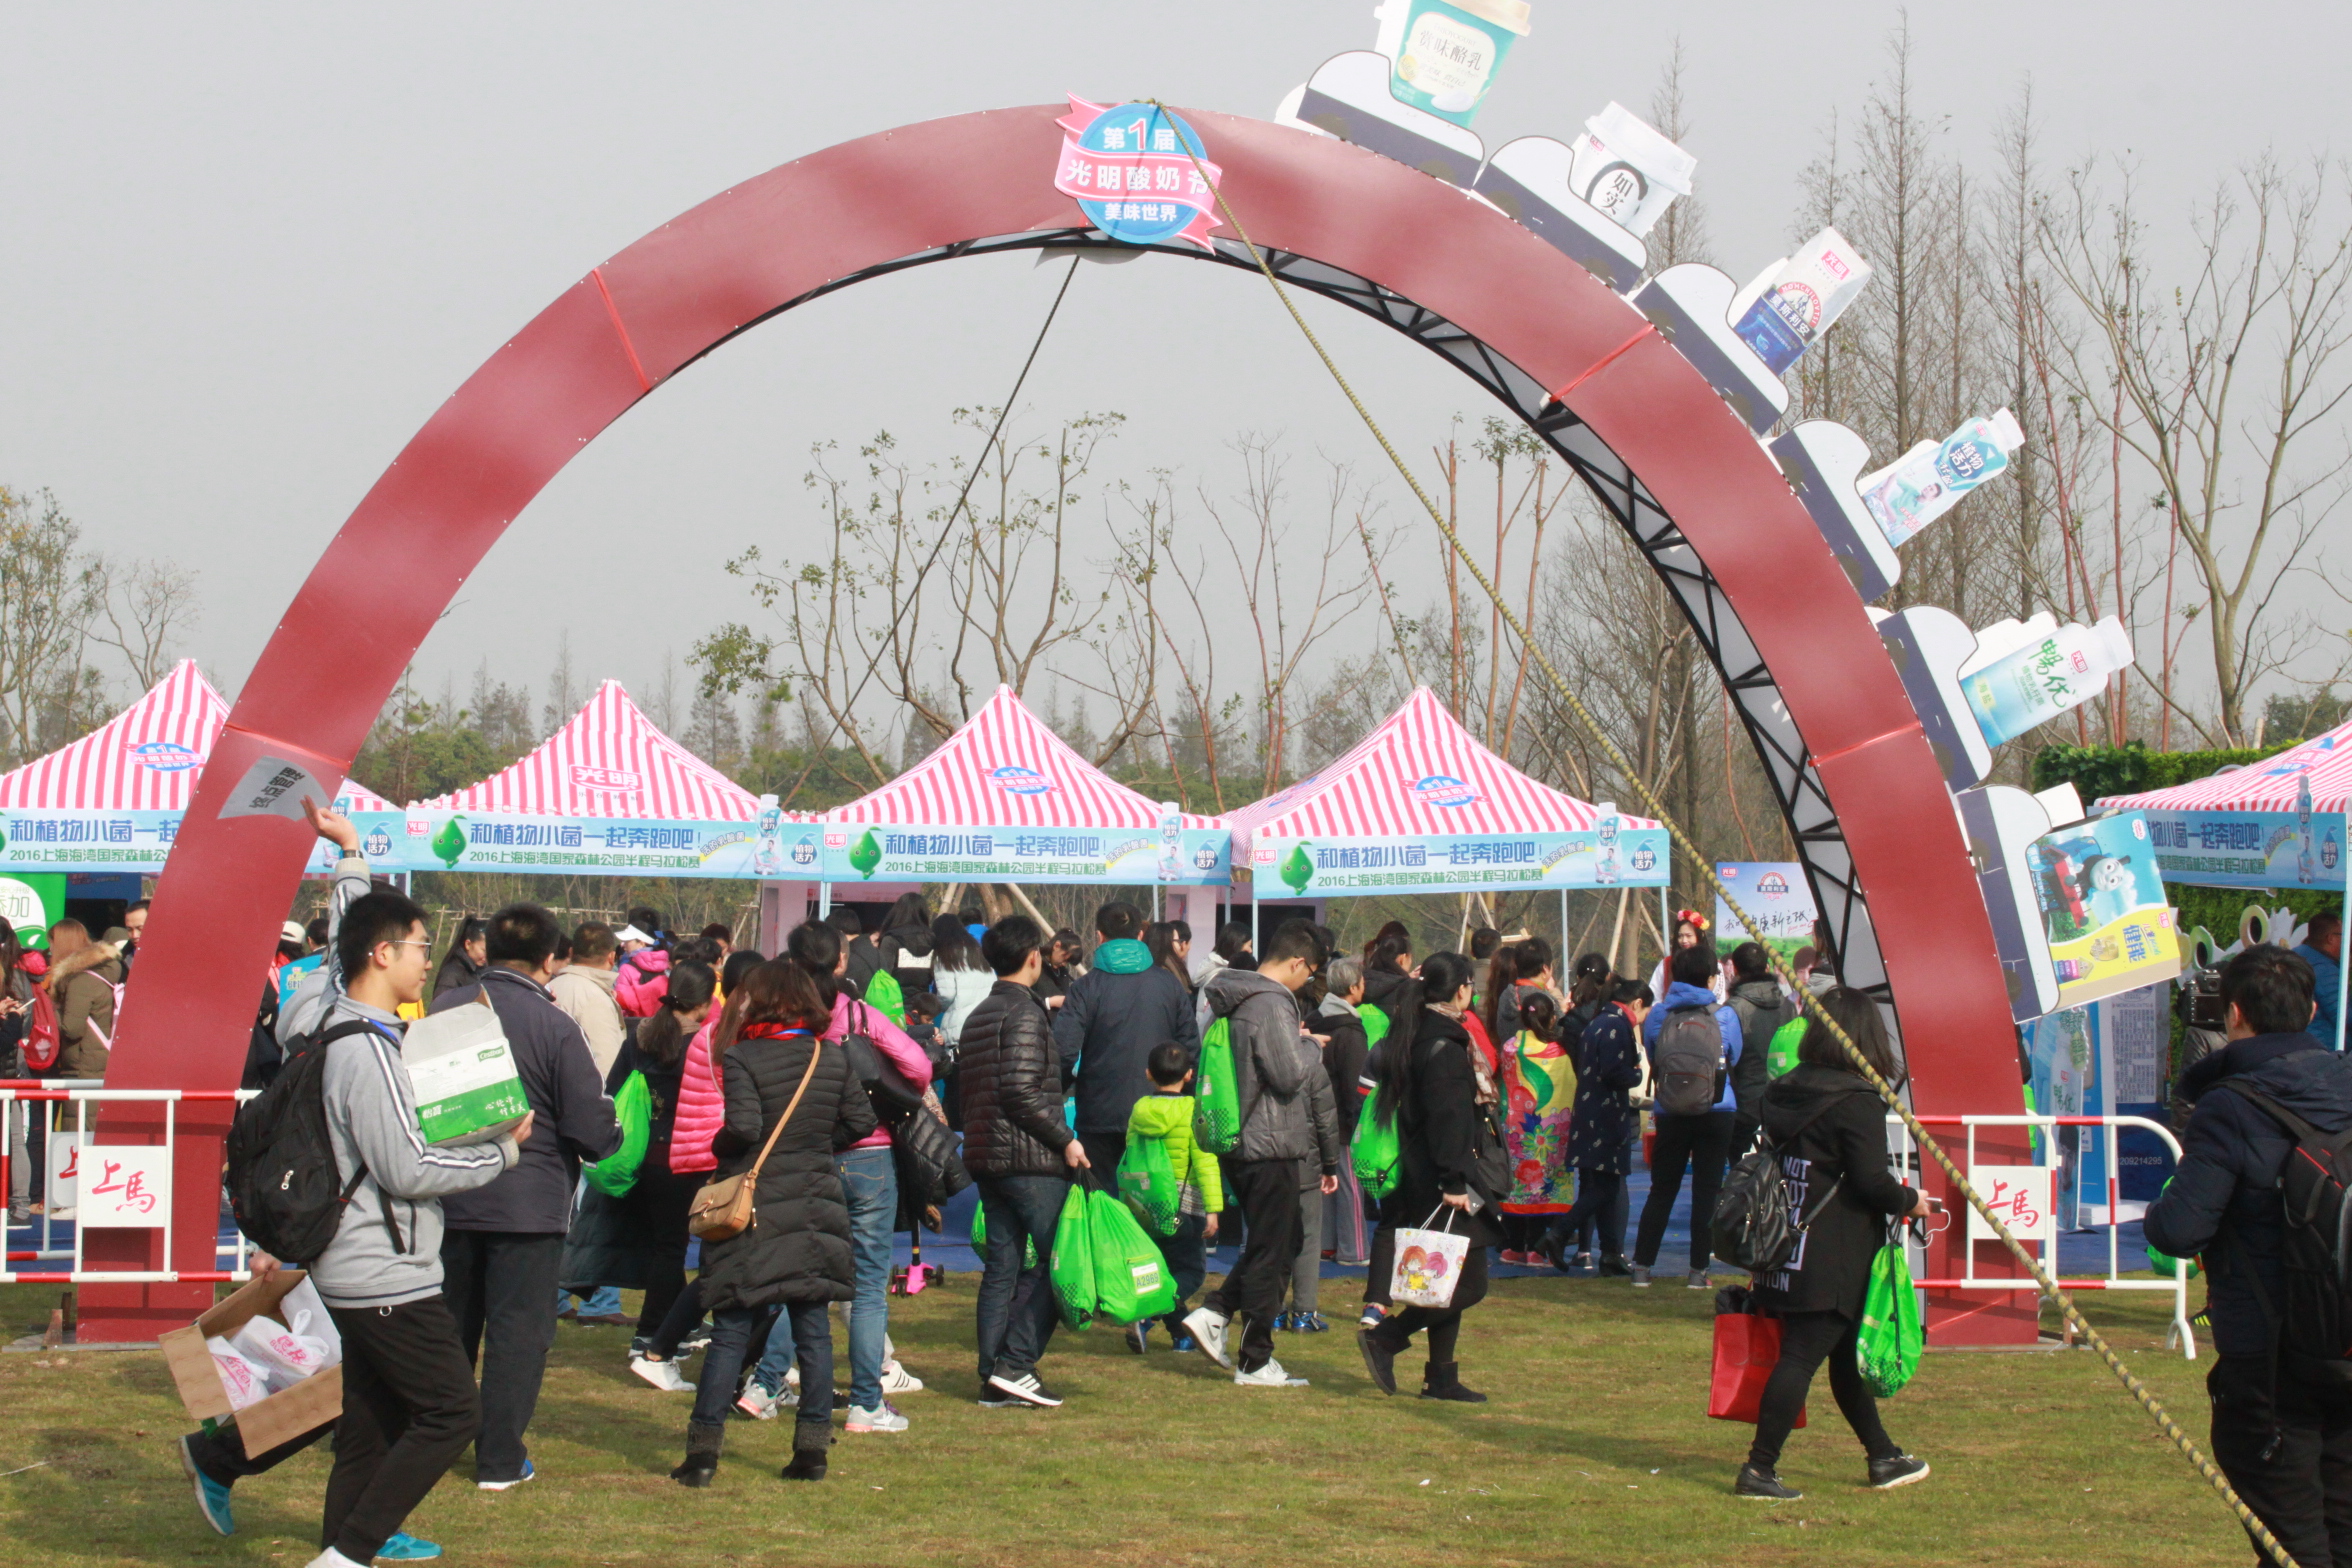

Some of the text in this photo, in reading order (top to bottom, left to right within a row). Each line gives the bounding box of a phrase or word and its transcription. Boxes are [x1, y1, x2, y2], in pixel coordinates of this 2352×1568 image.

[1419, 30, 1482, 71] 赏味酪乳
[1103, 118, 1175, 151] 第1届
[1065, 159, 1213, 195] 光明酸奶节
[1600, 172, 1634, 216] 如实
[1105, 202, 1177, 222] 美味世界
[1825, 251, 1848, 278] 光明
[1781, 282, 1820, 325] MOMCHILOVTSI
[1769, 293, 1810, 337] 莫斯利安
[1950, 448, 1975, 478] 活力
[1961, 440, 1984, 470] 植物
[2071, 650, 2087, 672] 光明
[248, 766, 305, 809] 终点管理
[576, 768, 639, 787] 光明
[408, 822, 428, 831] 光明
[470, 823, 701, 850] 和植物小菌一起奔跑吧！
[2147, 820, 2265, 851] 物小菌一起奔跑吧！
[368, 834, 388, 844] 植物
[368, 844, 388, 854] 活力
[700, 831, 746, 857] 活的乳酸菌
[794, 843, 814, 854] 植物
[826, 835, 846, 845] 光明
[885, 834, 1106, 858] 和植物小菌一起奔跑吧！
[10, 848, 171, 863] 2016上海海湾国家森林公
[470, 851, 700, 869] 2016上海海湾国家森林公园半程马拉松赛
[794, 853, 814, 863] 活力
[1196, 850, 1215, 859] 植物
[1196, 859, 1215, 868] 活力
[1255, 850, 1275, 860] 光明
[1316, 841, 1542, 869] 和植物小菌一起奔跑吧！
[1635, 850, 1653, 860] 植物
[1635, 859, 1653, 869] 活力
[2322, 853, 2337, 866] 活力
[885, 861, 1107, 876] 2016上海海湾国家森林公园半程马拉松赛
[1318, 869, 1543, 886] 2016上海海湾国家森林公园半程马拉松赛
[2122, 923, 2147, 963] 健能
[91, 1159, 156, 1213] 上馬
[1985, 1178, 2039, 1228] 上馬
[1136, 1272, 1159, 1287] A2969
